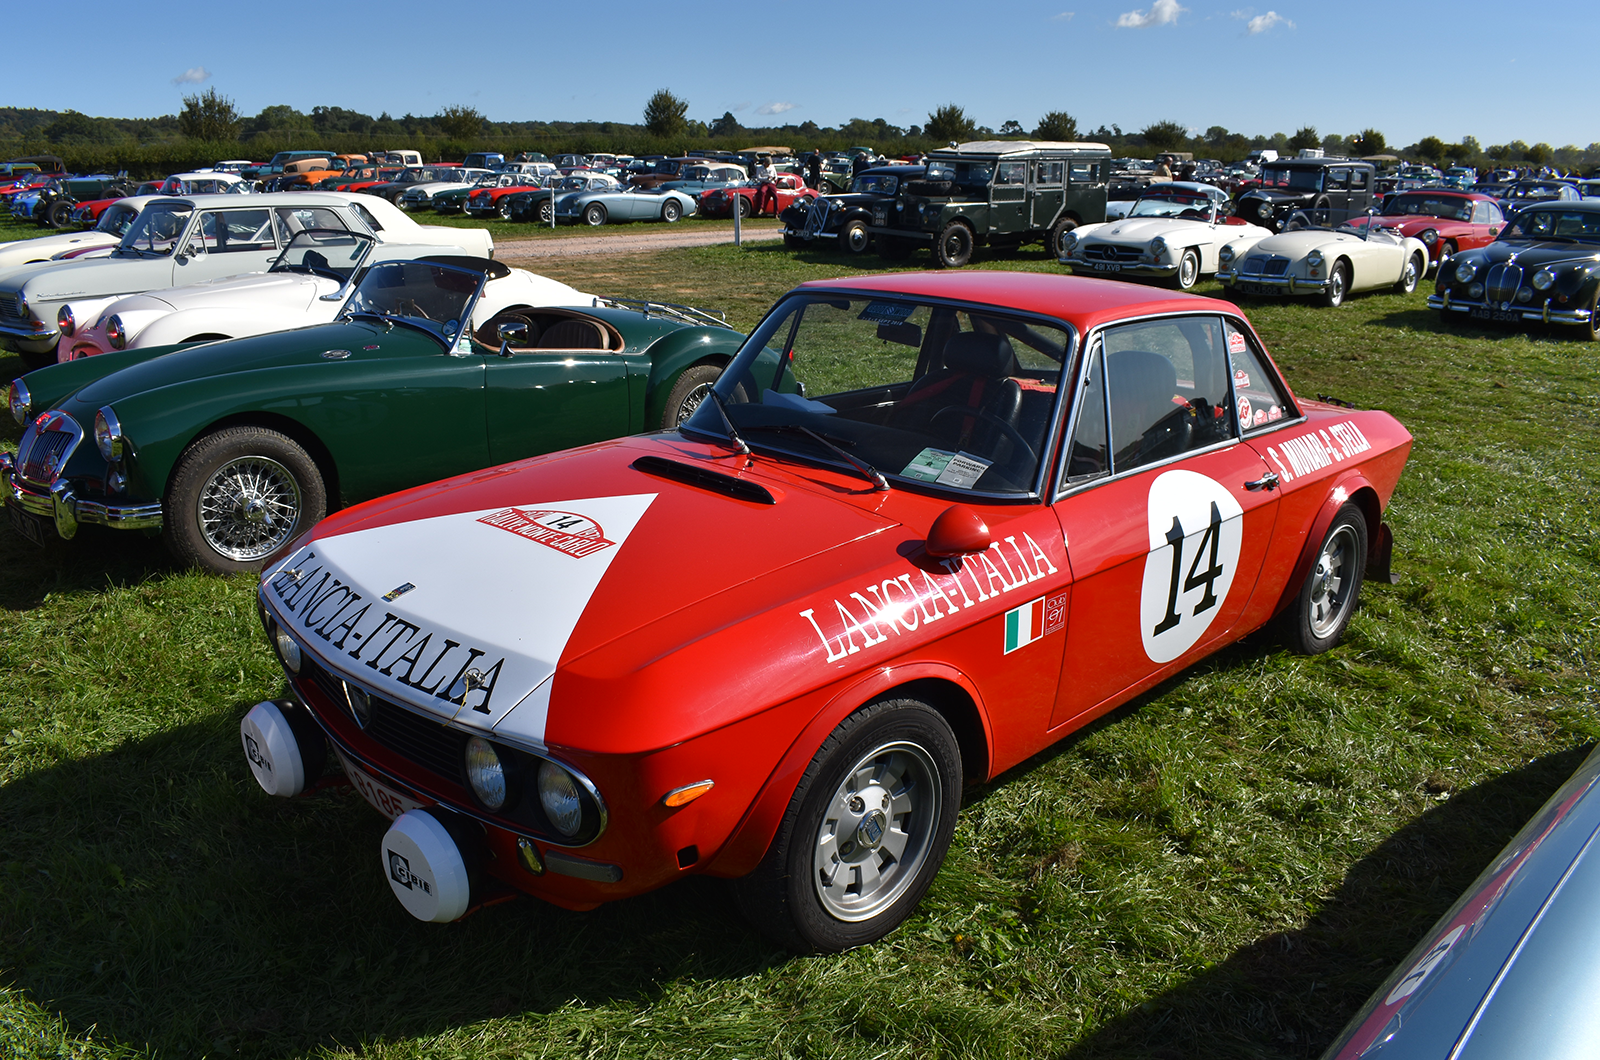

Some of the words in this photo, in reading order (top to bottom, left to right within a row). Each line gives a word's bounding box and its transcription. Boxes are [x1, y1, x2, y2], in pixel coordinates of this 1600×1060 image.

[1262, 286, 1278, 295] 505
[1470, 309, 1490, 319] AAB
[1492, 311, 1519, 322] 250A
[546, 515, 583, 530] 14
[799, 531, 1058, 664] LANCIA-ITALIA
[1153, 501, 1224, 637] 14
[272, 552, 505, 715] LANCIA-ITALIA
